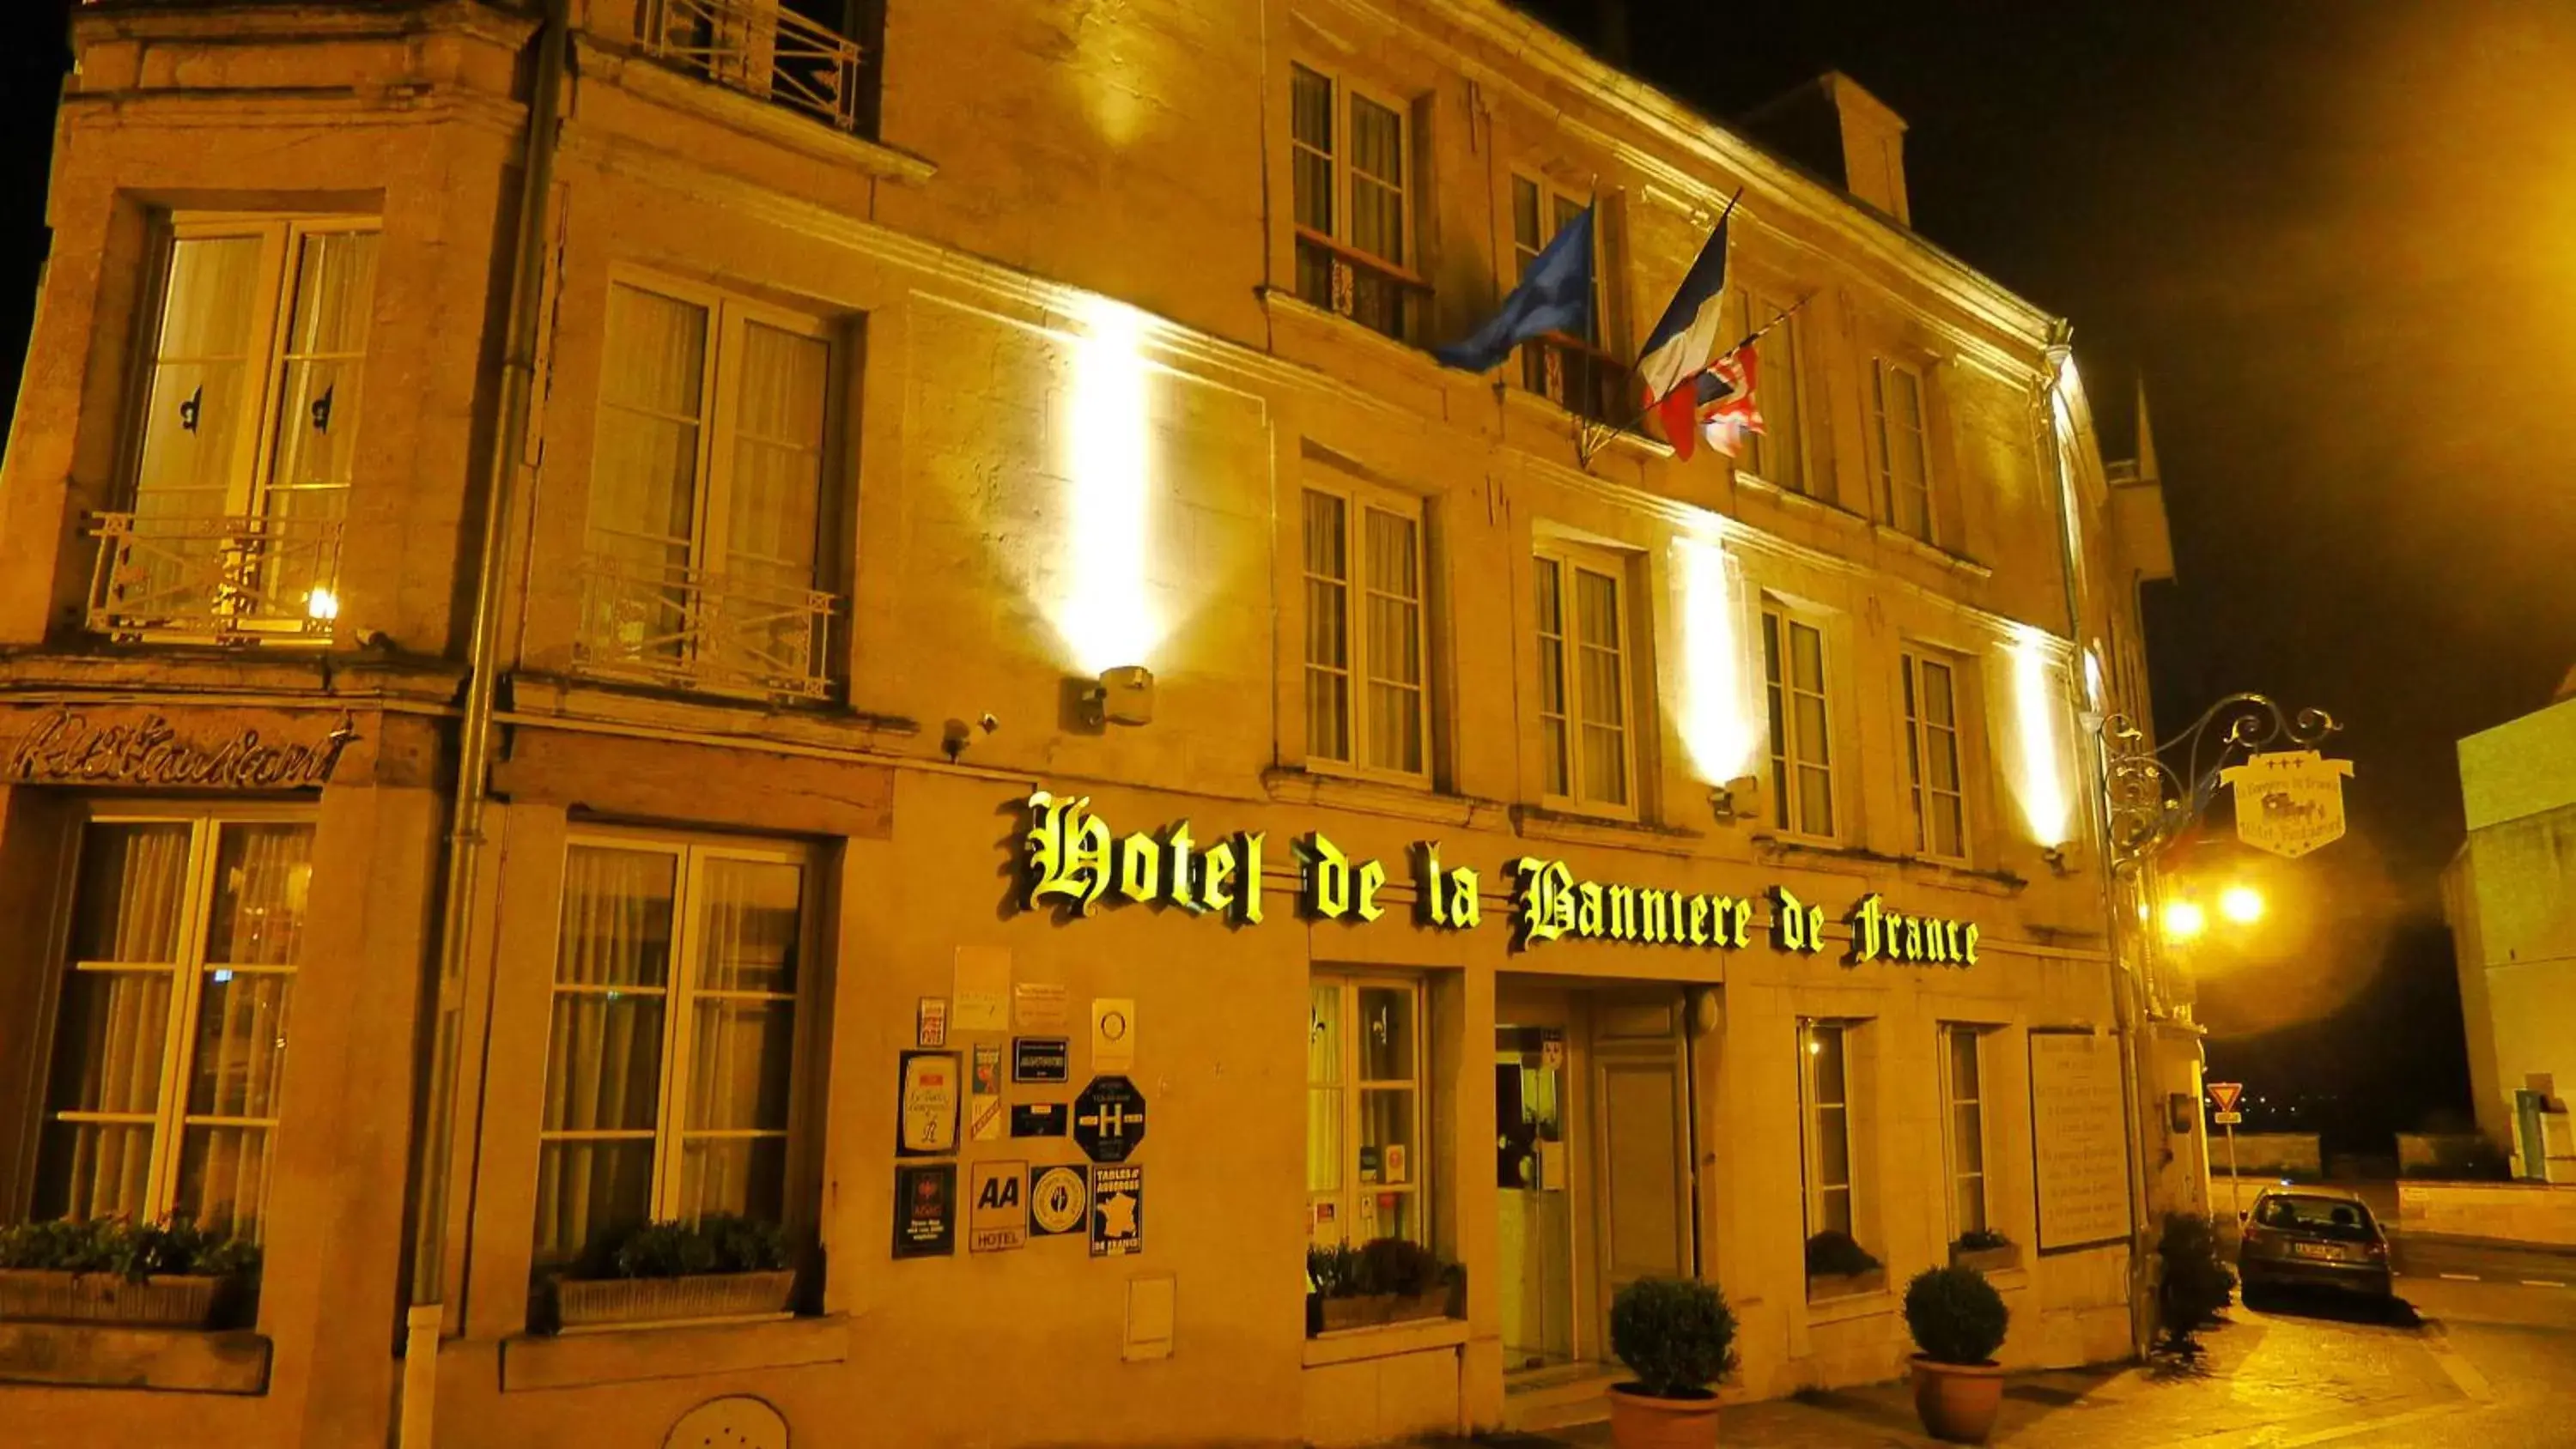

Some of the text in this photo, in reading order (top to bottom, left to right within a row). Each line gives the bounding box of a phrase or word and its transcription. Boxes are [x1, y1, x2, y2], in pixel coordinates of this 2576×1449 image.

[1025, 790, 1980, 966] Hotel de la Banniere de France
[1099, 1103, 1123, 1137] H
[977, 1176, 1018, 1210] AA
[977, 1231, 1018, 1247] HOTEL
